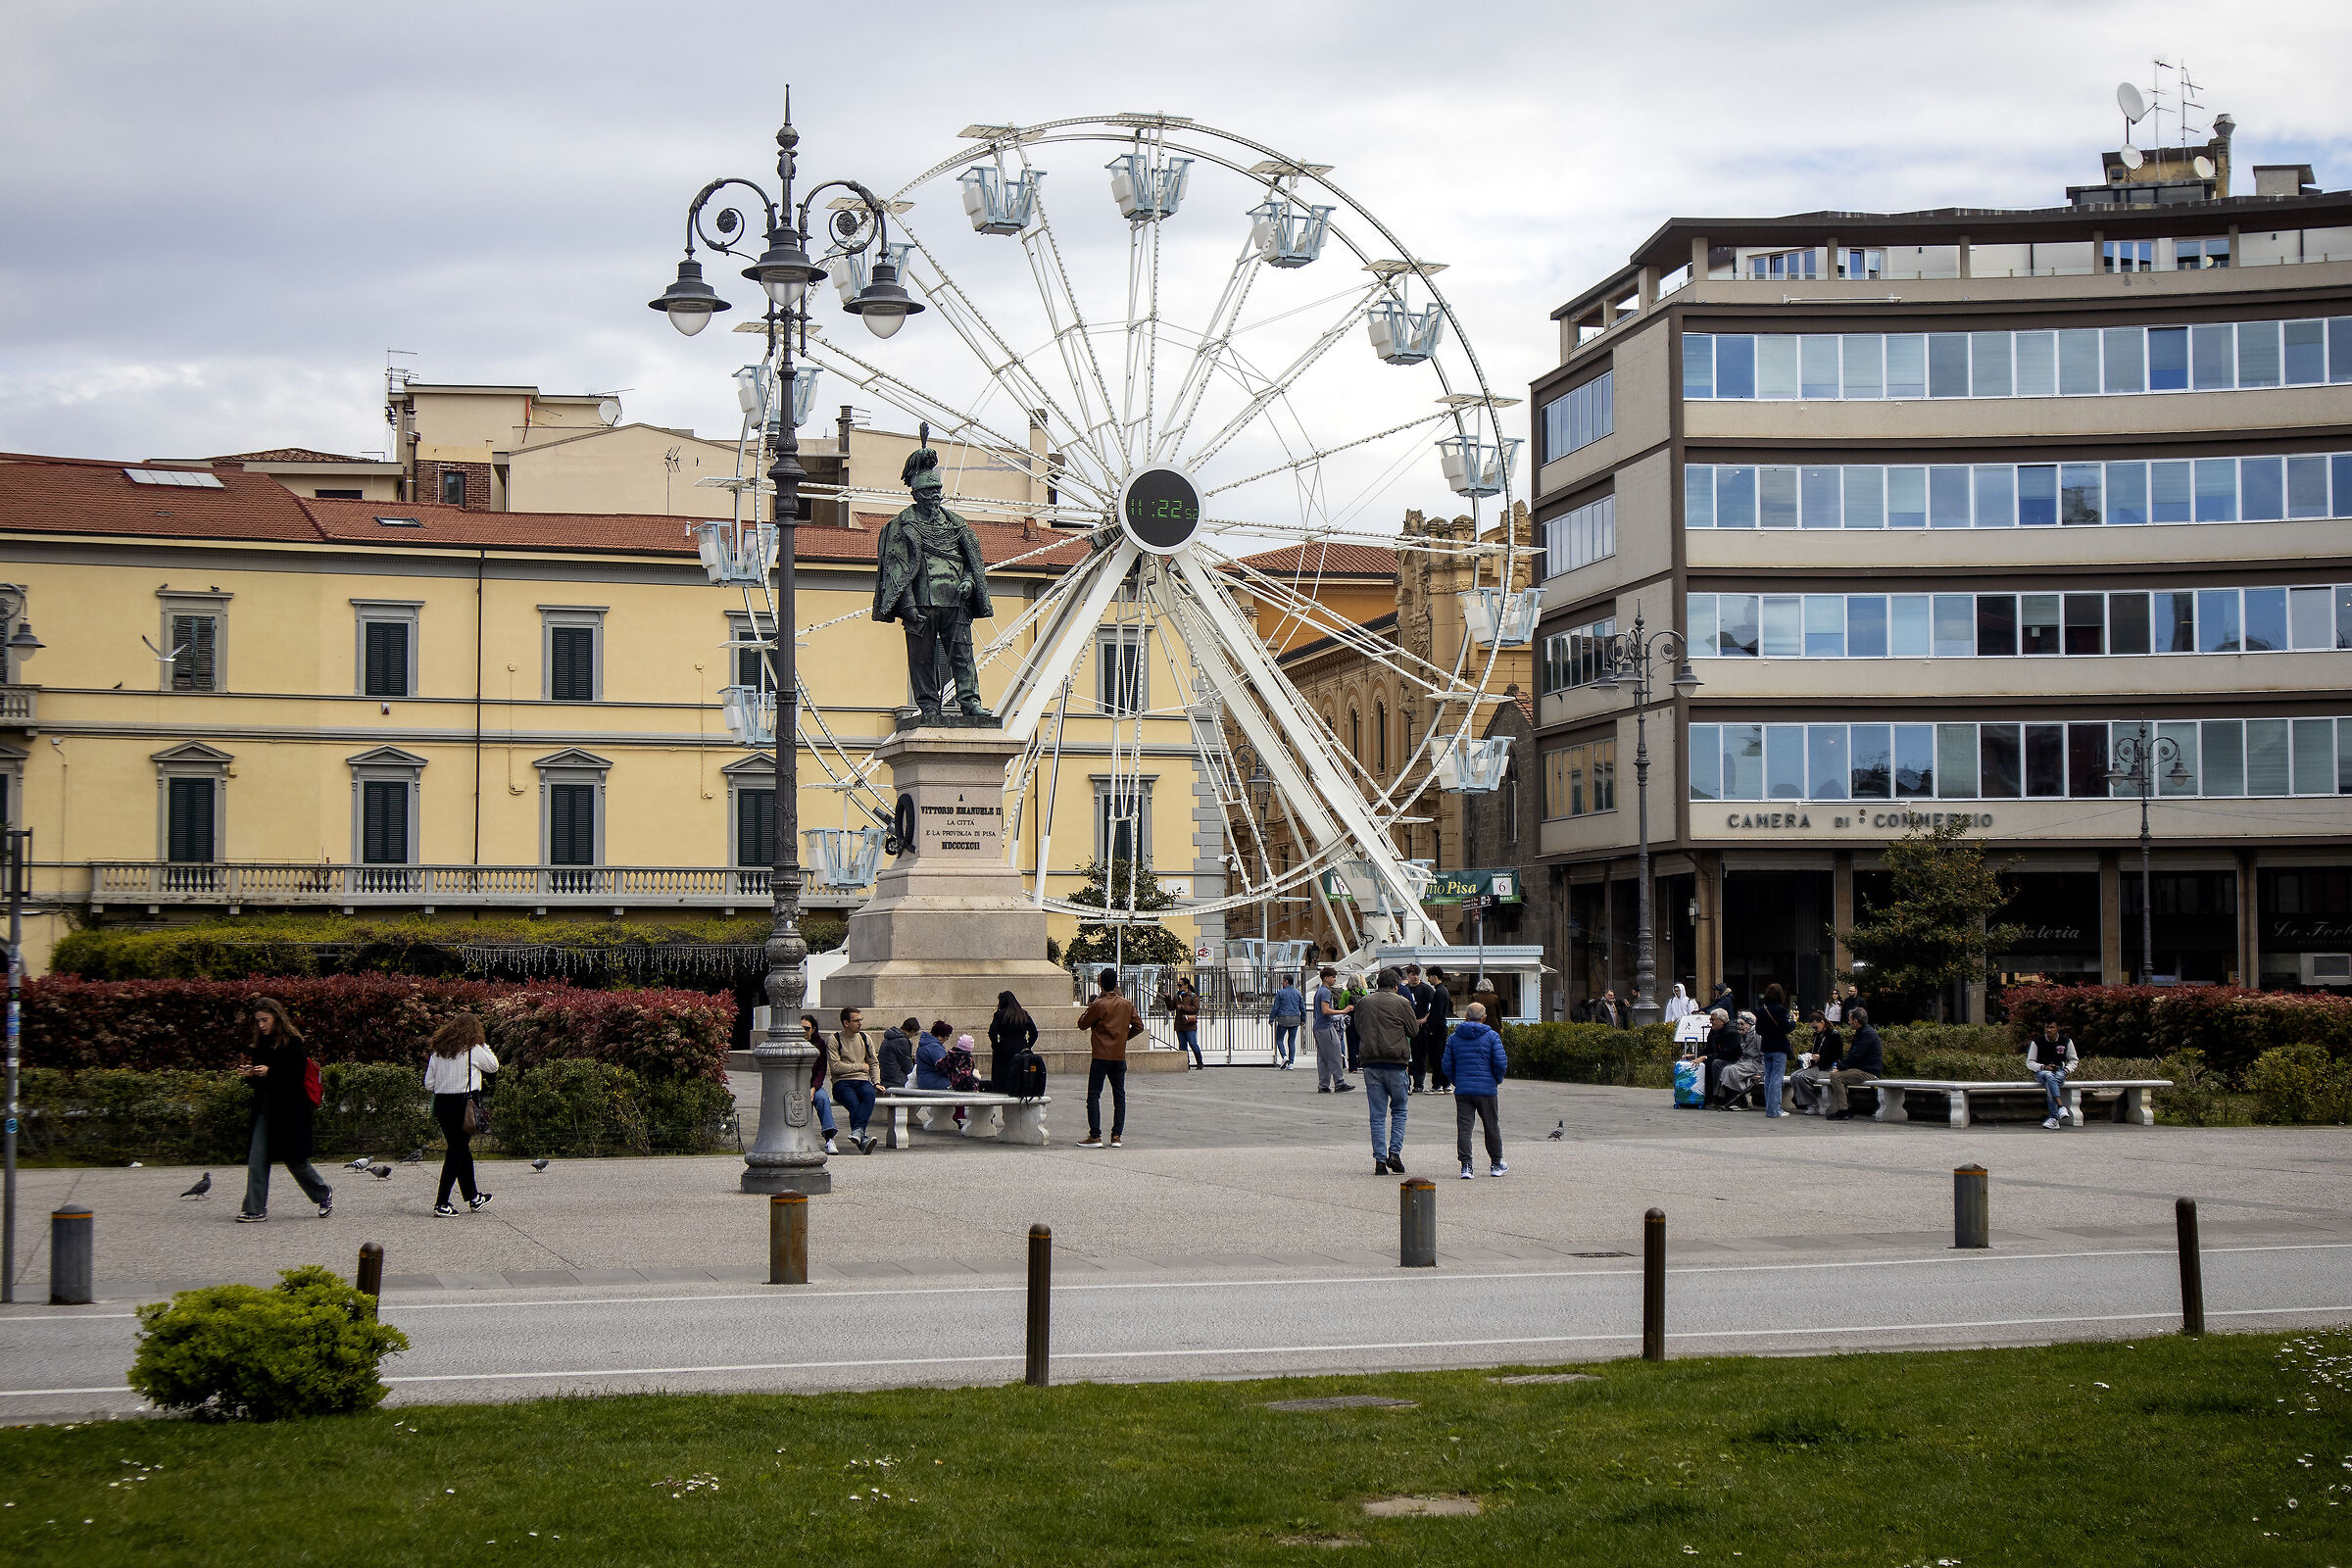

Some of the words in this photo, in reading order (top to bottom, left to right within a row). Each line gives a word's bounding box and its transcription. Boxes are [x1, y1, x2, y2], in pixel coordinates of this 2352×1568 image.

[956, 807, 994, 815] EMANUELE
[1728, 812, 1811, 829] CAMERA
[1834, 816, 1851, 828] DI
[1446, 881, 1478, 895] Pisa
[1498, 880, 1506, 893] 6
